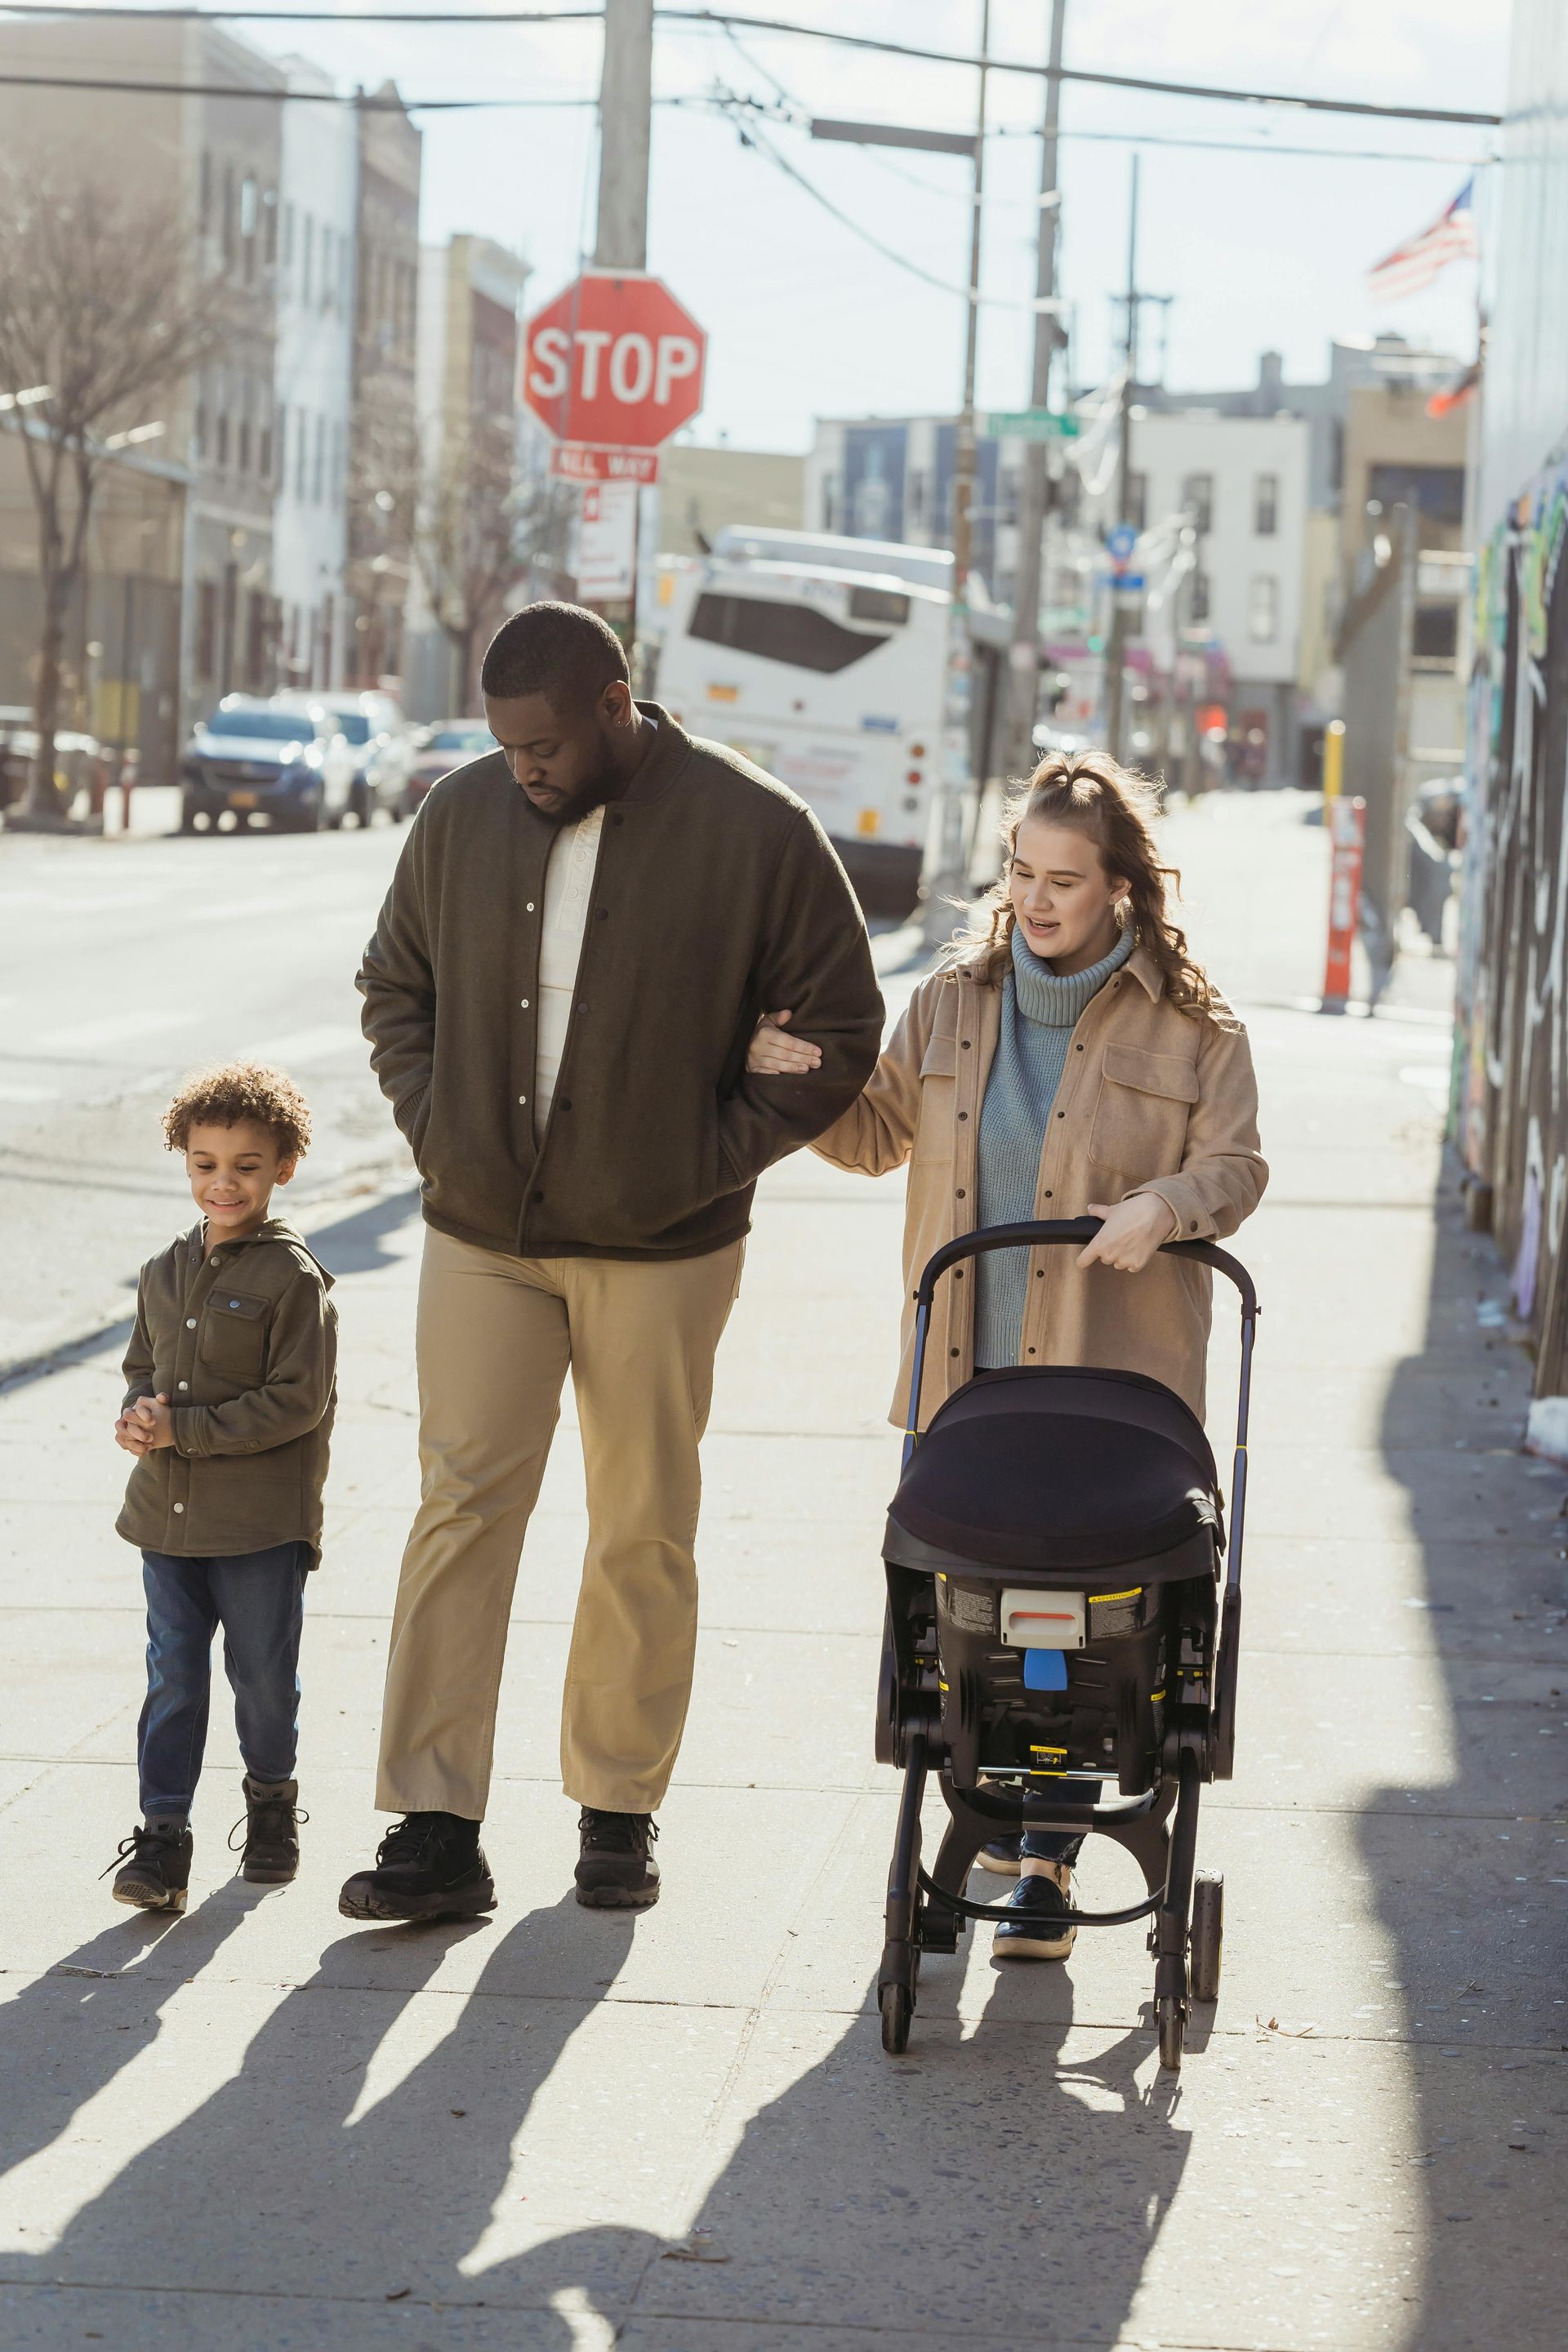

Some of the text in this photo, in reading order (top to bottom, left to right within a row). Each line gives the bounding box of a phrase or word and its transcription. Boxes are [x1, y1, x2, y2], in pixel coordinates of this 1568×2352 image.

[530, 327, 699, 406] STOP
[558, 450, 653, 477] ALL WAY
[1098, 1592, 1136, 1601] ADVERTENCIA
